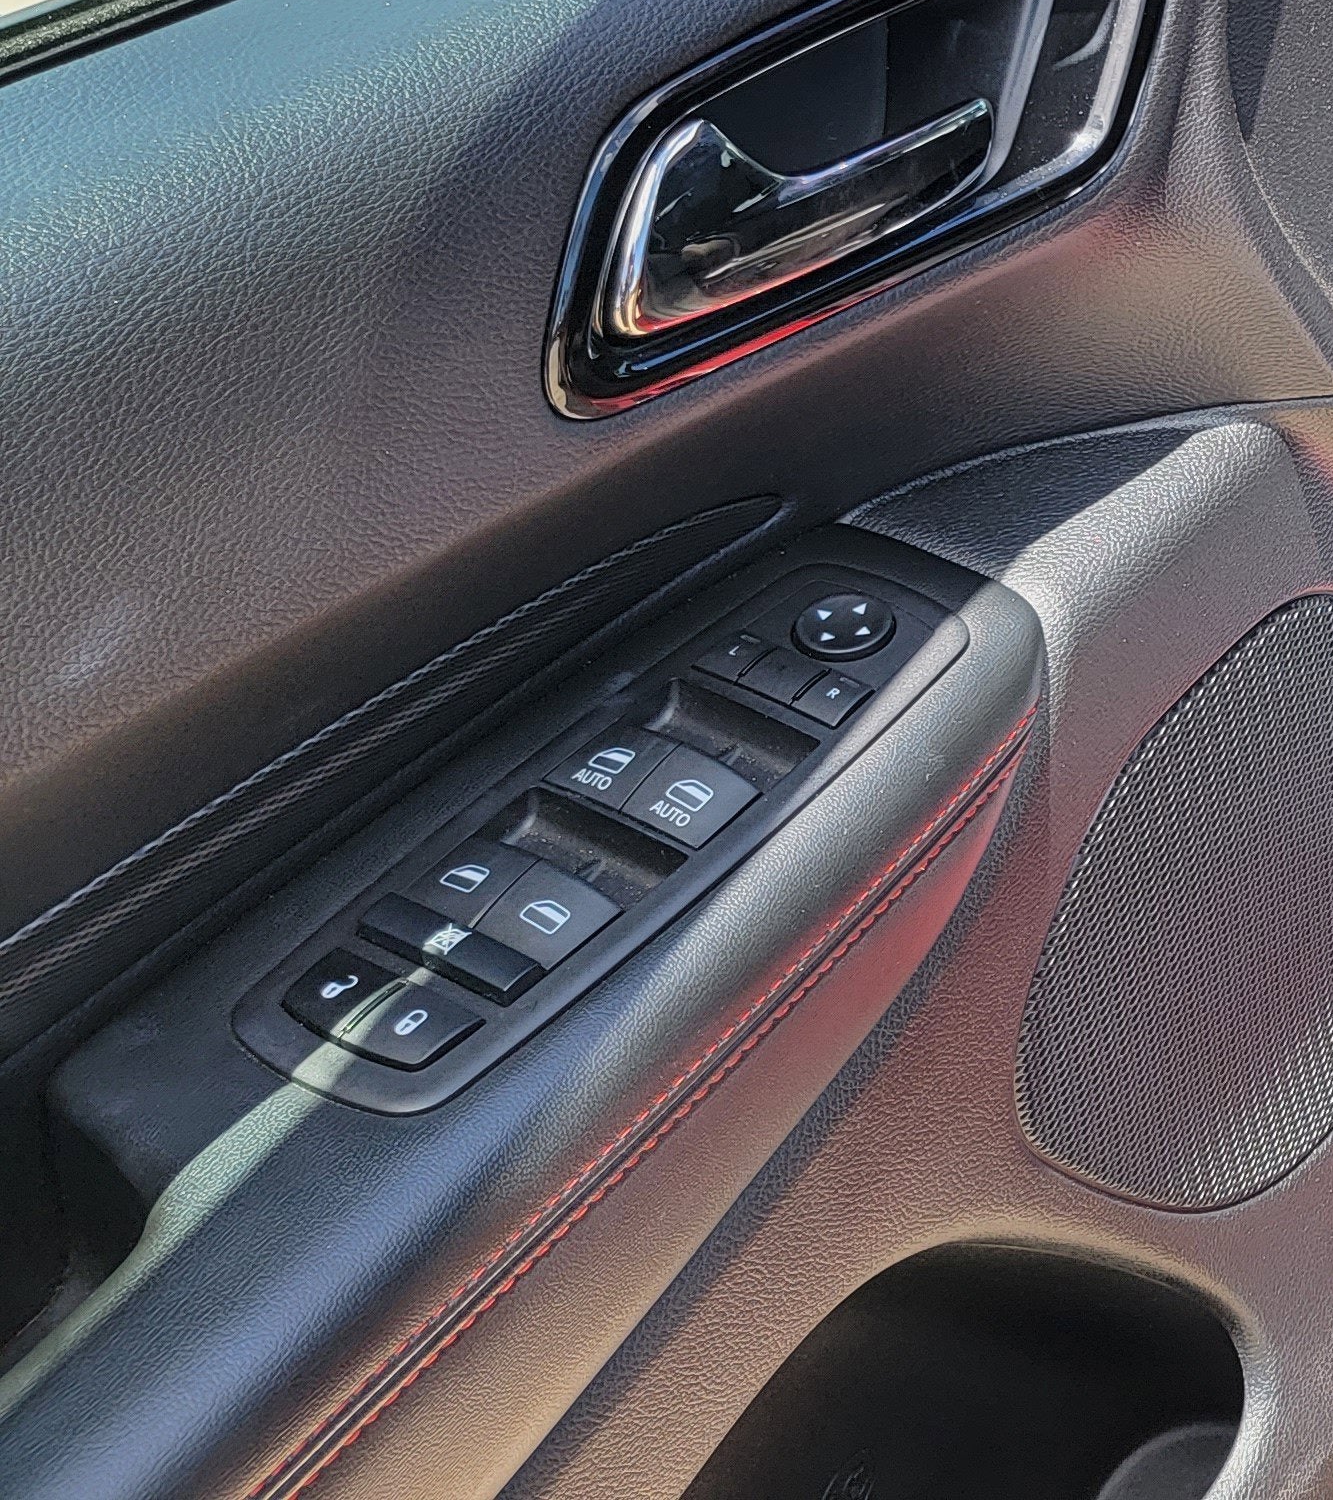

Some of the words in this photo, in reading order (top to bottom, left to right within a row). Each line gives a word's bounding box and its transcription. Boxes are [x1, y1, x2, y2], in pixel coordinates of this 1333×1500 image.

[728, 645, 740, 657] L
[825, 687, 841, 699] R
[571, 768, 613, 791] AUTO
[649, 800, 691, 827] AUTO
